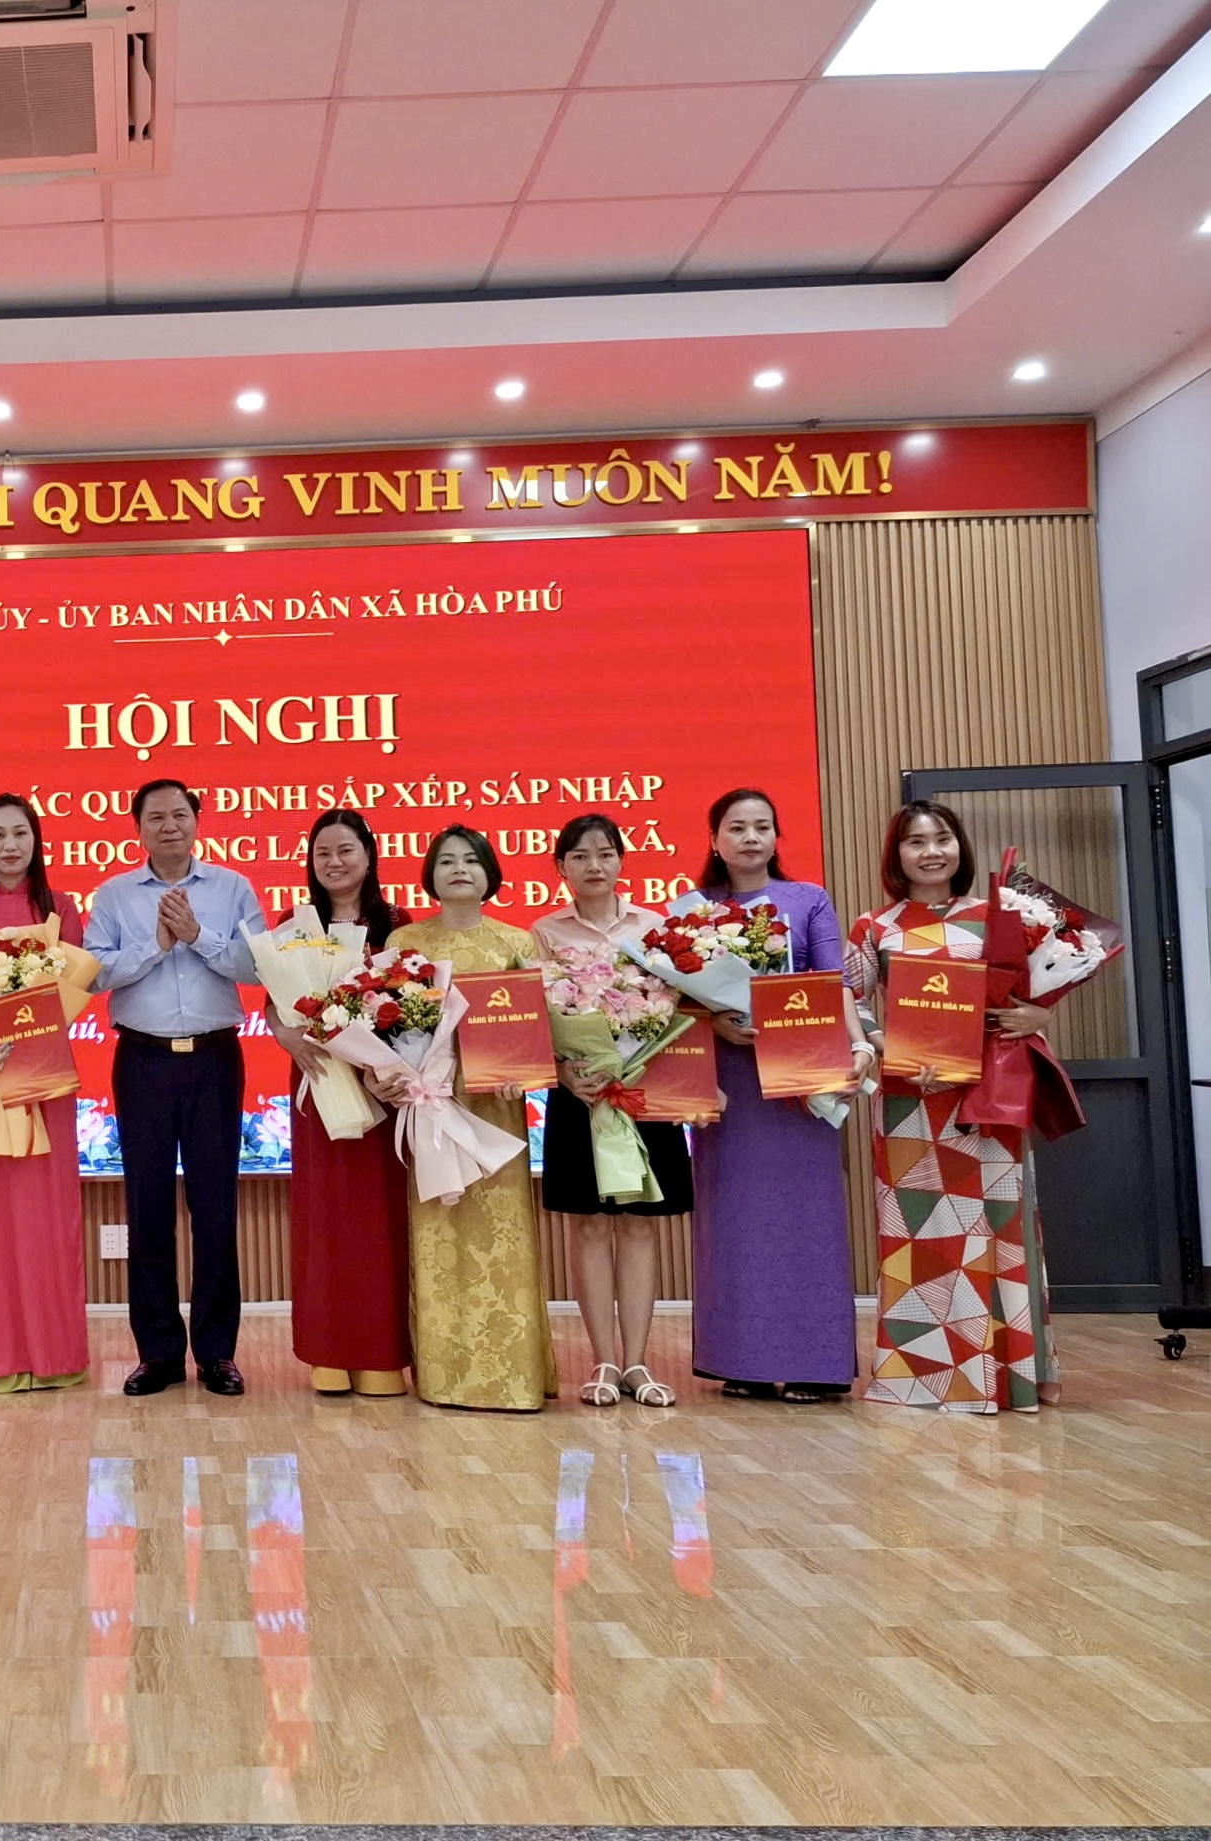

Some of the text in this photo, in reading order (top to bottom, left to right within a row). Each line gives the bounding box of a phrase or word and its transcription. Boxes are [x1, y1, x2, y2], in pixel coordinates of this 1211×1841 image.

[33, 475, 266, 534] QUANG
[284, 467, 465, 517] VINH
[486, 447, 691, 512] MUÔN
[713, 442, 892, 501] NĂM!
[58, 600, 101, 628] ỦY
[109, 602, 174, 627] BAN
[183, 593, 275, 624] NHÂN
[284, 591, 351, 621] DÂN
[360, 589, 407, 618] XÃ
[416, 586, 489, 616] HÒA
[495, 581, 564, 612] PHÚ
[64, 693, 402, 761] HỘI NGHỊ
[17, 785, 72, 817] ÁC
[81, 788, 208, 821] QUT
[214, 785, 309, 818] ĐỊNH
[317, 776, 386, 809] SẮP
[393, 774, 473, 811] XẾP,
[481, 772, 551, 806] SÁP
[558, 771, 664, 808] NHẬP
[62, 839, 140, 872] HỌC
[266, 830, 309, 868] LẬ
[499, 828, 561, 855] UB
[264, 885, 312, 912] TR
[380, 879, 513, 909] THC
[523, 874, 632, 908] ĐẢG
